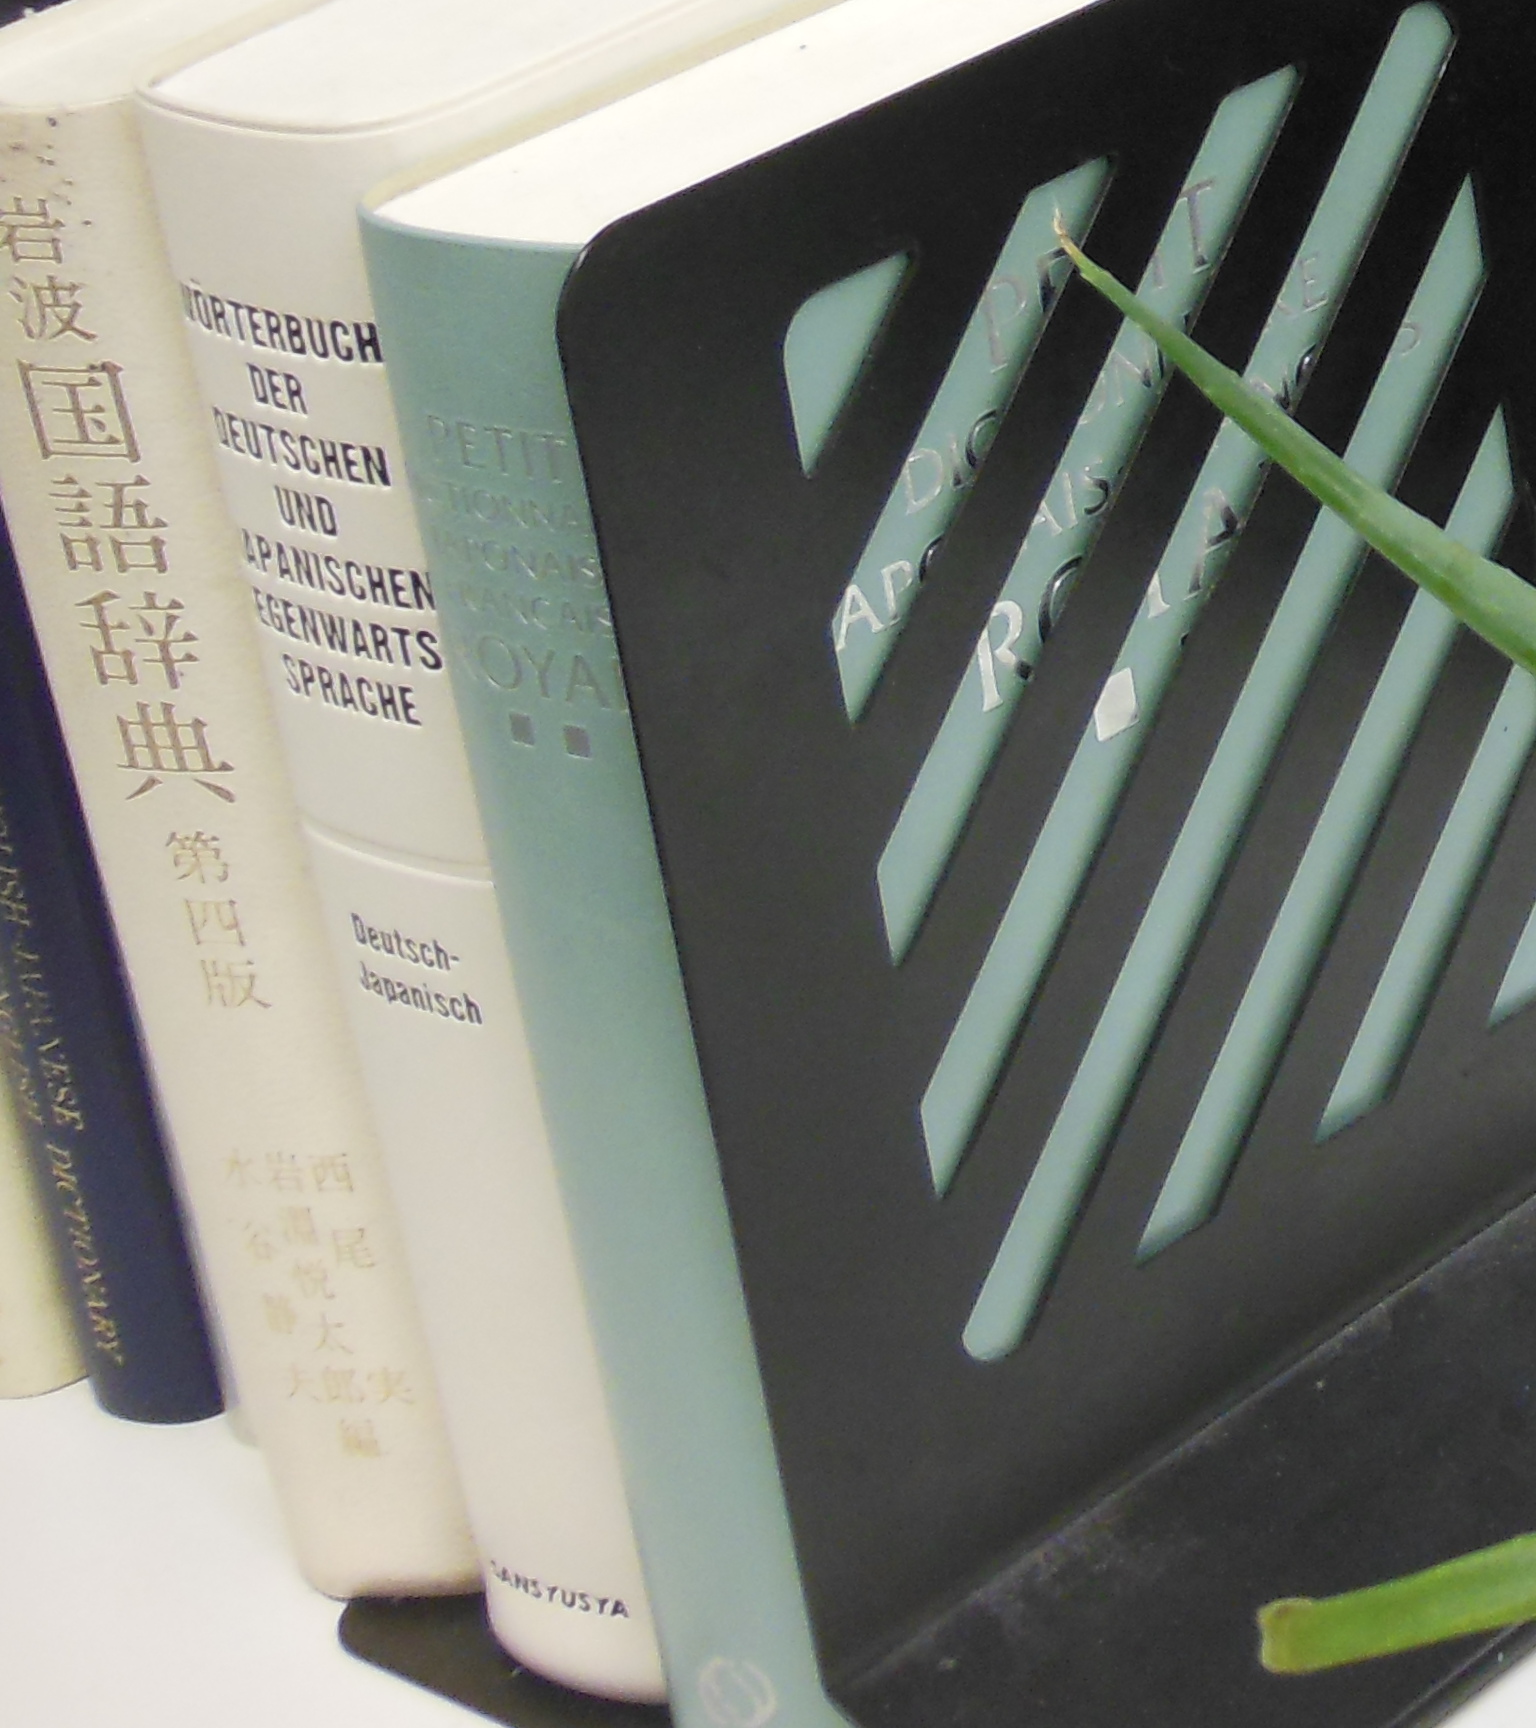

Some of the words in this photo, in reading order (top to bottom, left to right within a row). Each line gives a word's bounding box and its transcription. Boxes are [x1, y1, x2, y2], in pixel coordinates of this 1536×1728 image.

[246, 362, 309, 415] DER
[212, 406, 392, 487] DEUTSCHEN
[425, 414, 568, 485] PETIT
[274, 484, 338, 537] UND
[241, 527, 436, 611] APANISCHEN
[252, 585, 443, 670] EGENWARTS
[281, 653, 422, 727] SPRACHE
[164, 829, 273, 1010] 第四版
[350, 912, 460, 971] Deutsch-
[359, 960, 483, 1025] Japanisch
